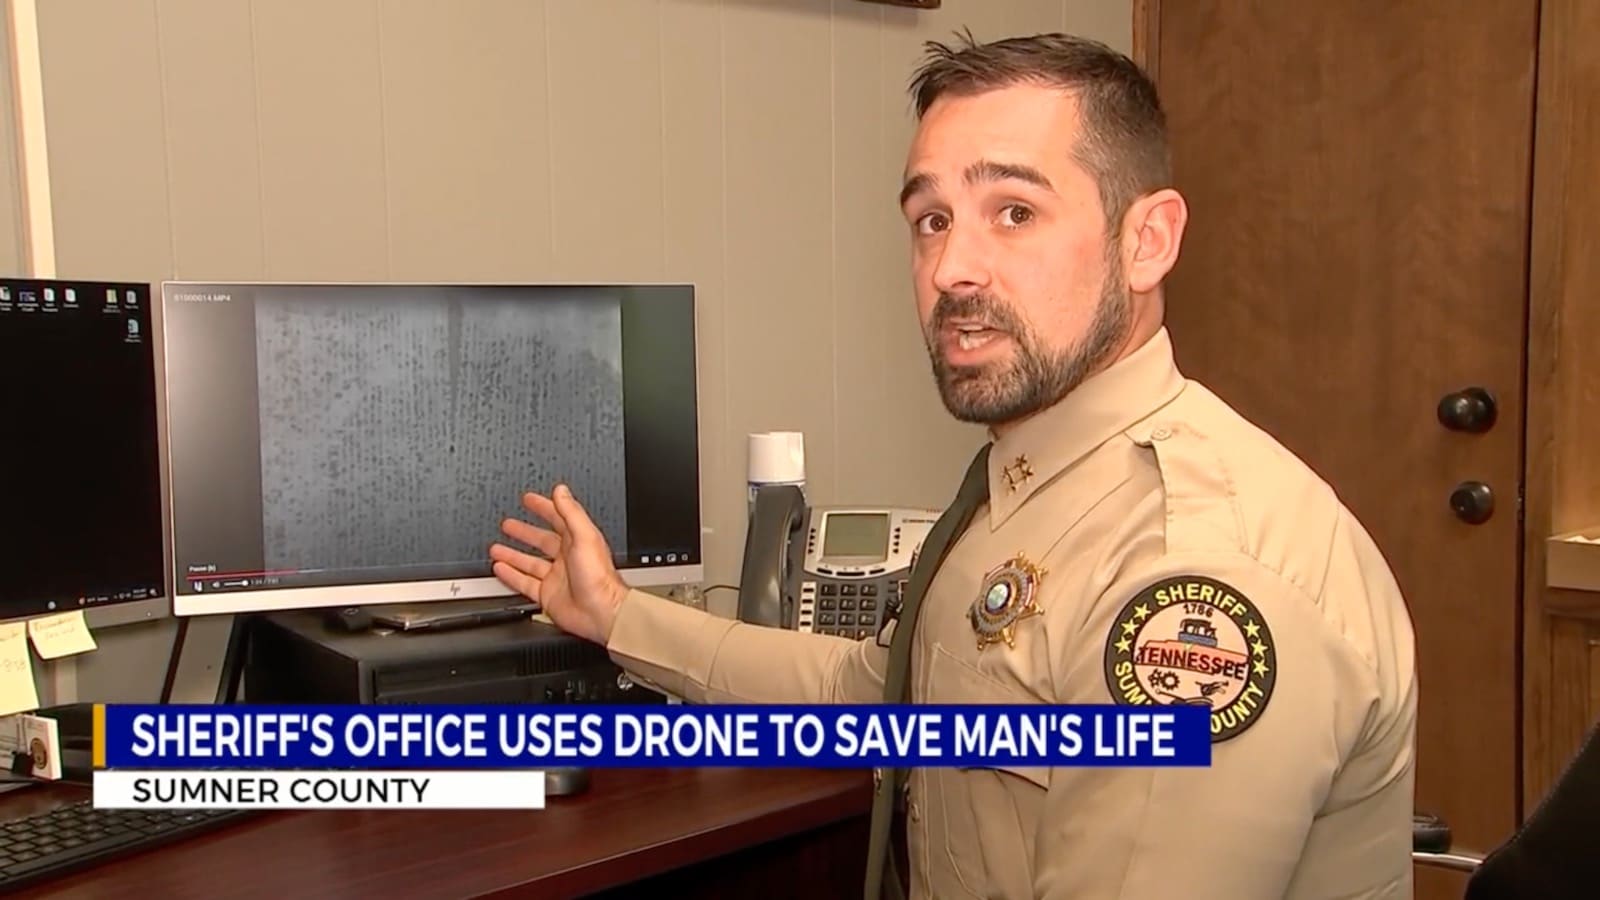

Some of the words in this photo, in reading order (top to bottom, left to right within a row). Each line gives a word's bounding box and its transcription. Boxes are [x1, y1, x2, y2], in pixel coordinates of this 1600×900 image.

[1154, 582, 1248, 619] SHERIFF
[1182, 602, 1215, 619] 1786
[1136, 645, 1249, 681] TENNESSEE
[1114, 660, 1153, 706] SUM
[1211, 681, 1265, 734] OUNTY
